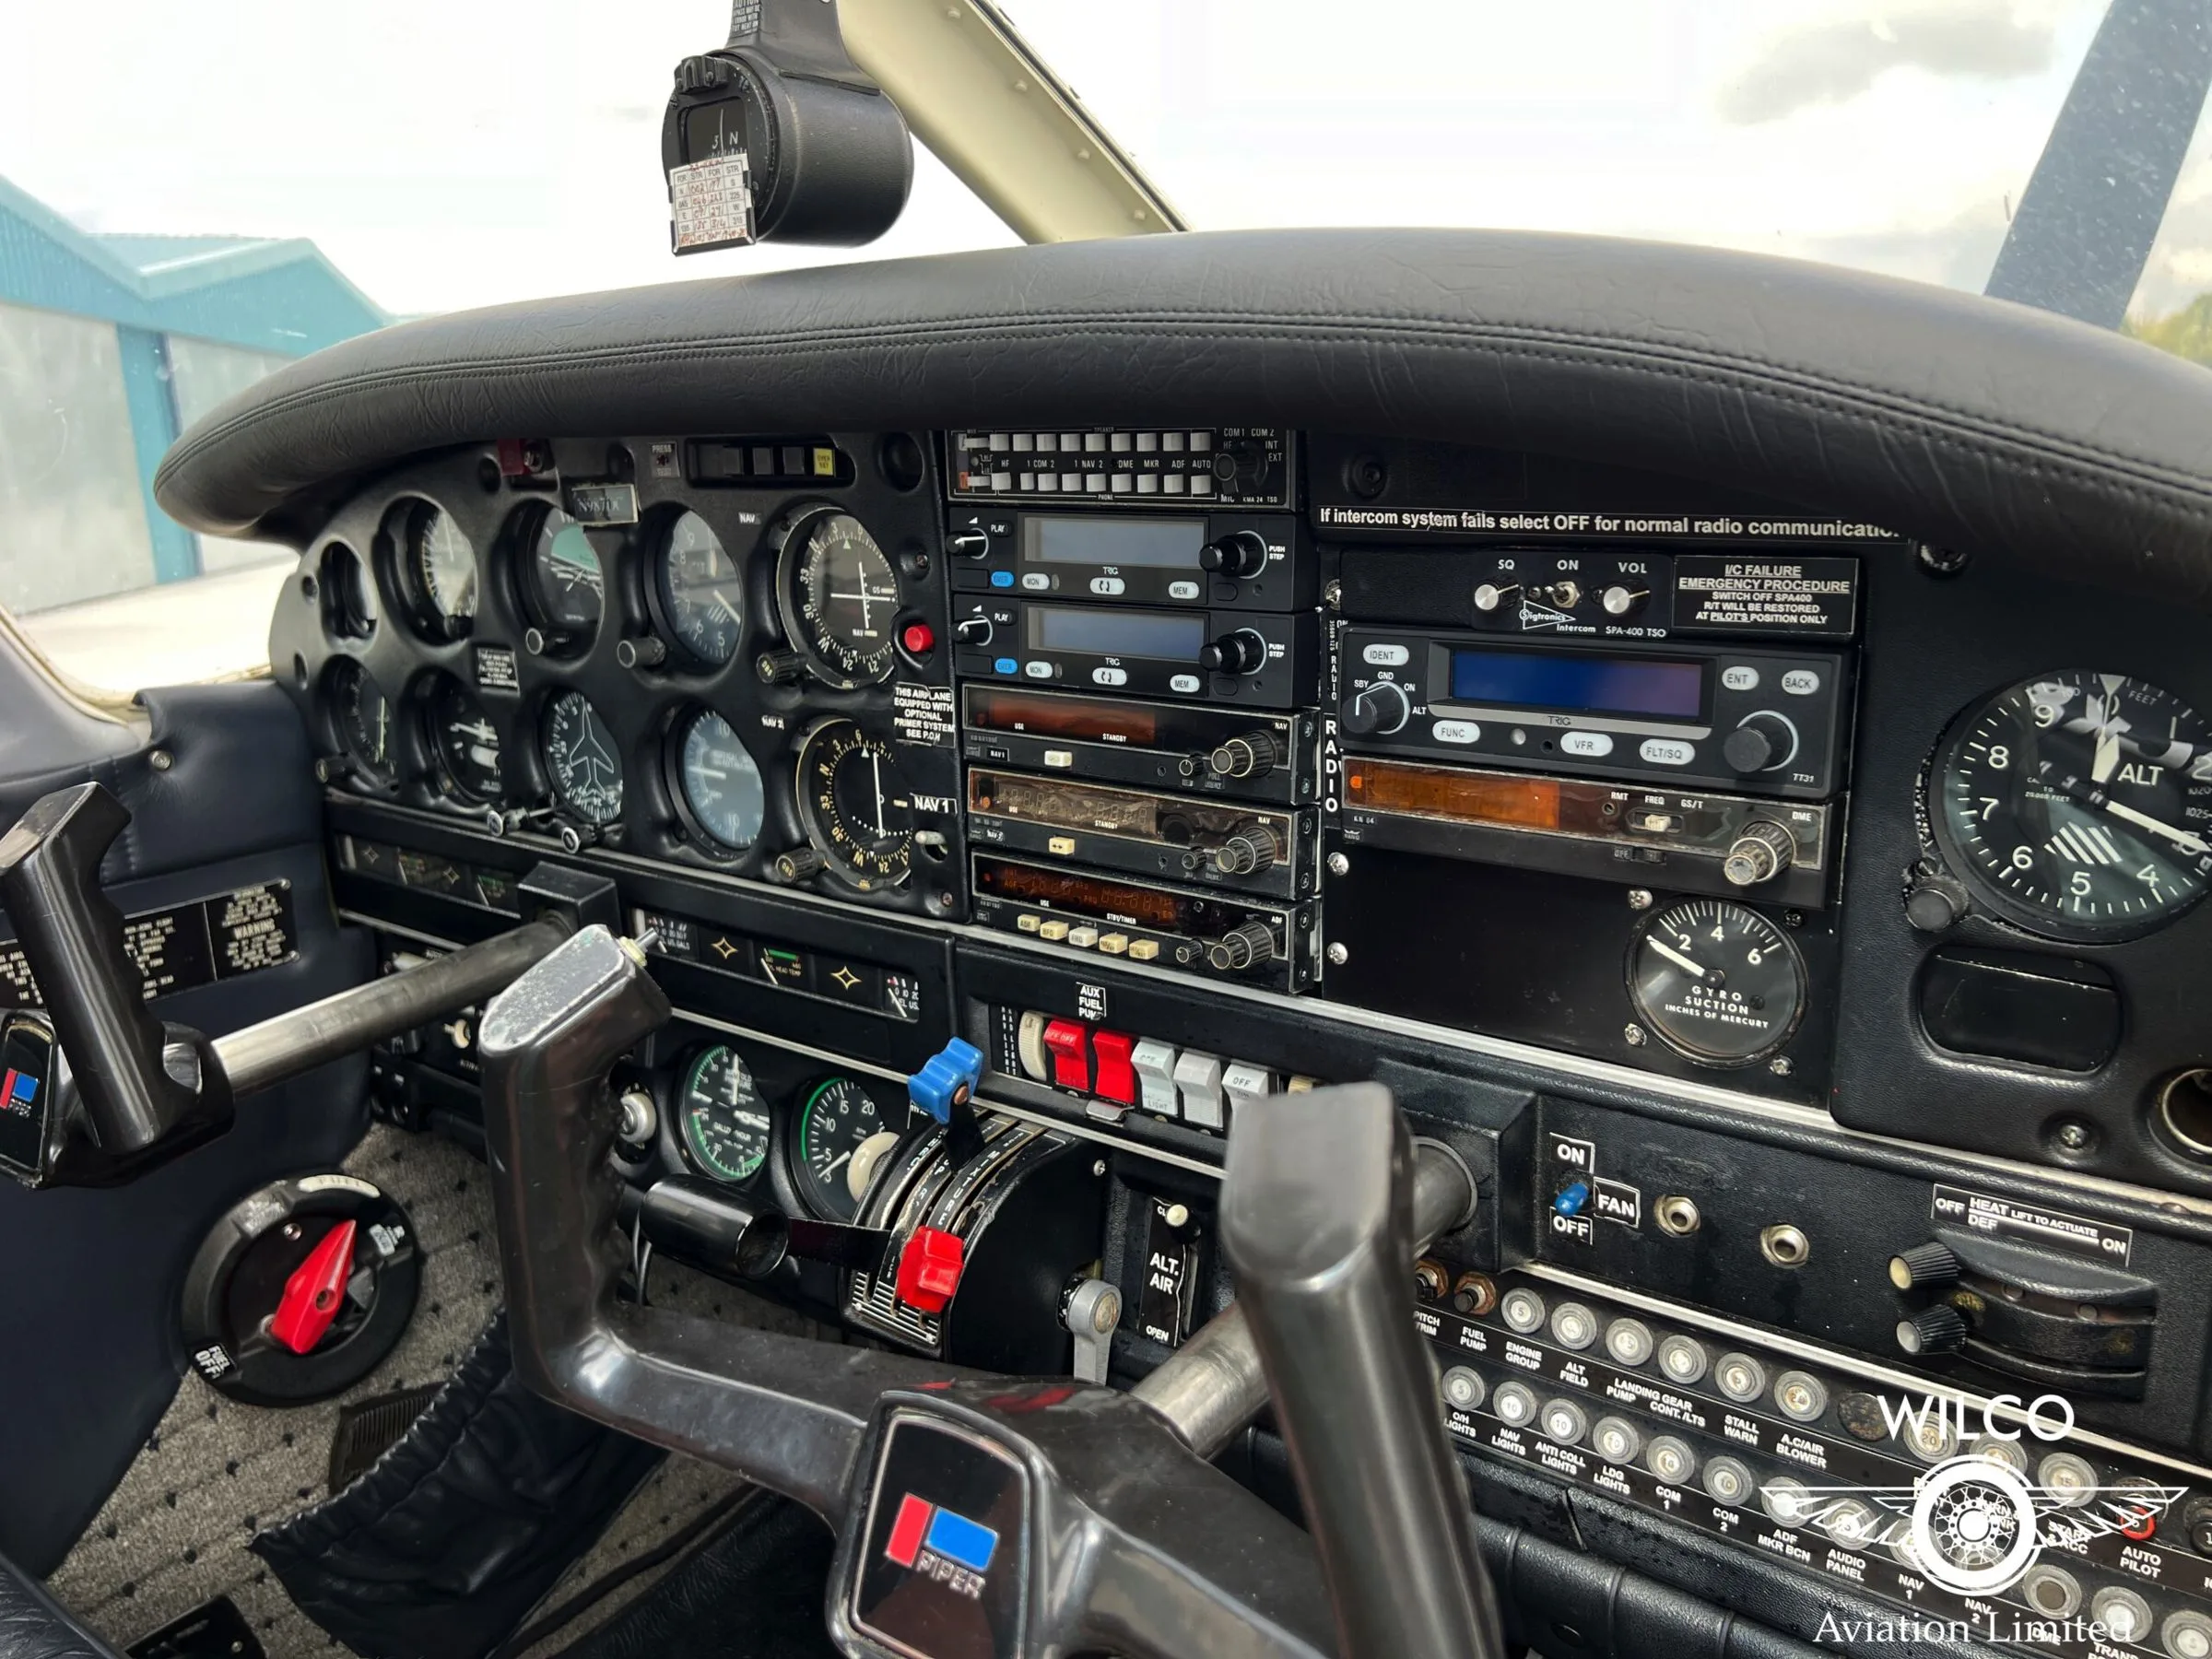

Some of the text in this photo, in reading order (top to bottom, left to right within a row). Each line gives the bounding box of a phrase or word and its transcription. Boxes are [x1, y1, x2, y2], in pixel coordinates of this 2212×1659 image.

[729, 131, 739, 145] N
[1172, 460, 1185, 469] ADF
[1192, 461, 1211, 469] AUTO
[1268, 453, 1282, 462] EXT
[990, 524, 1005, 534] PLAY
[1320, 508, 1330, 523] If
[1334, 508, 1398, 525] intercom
[1402, 512, 1457, 529] system
[1461, 512, 1495, 529] fails
[1500, 514, 1551, 530] select
[1553, 515, 1590, 530] OFF
[1594, 515, 1621, 531] for
[1625, 518, 1688, 534] normal
[1694, 518, 1743, 535] radio
[1498, 559, 1647, 574] SQ ON VOL
[1724, 564, 1802, 577] I/C FAILURE
[1174, 586, 1188, 595] MEM
[1678, 577, 1850, 592] EMERGENCY PROCEDURE
[1712, 591, 1812, 602] SWITCH OFF SPA400
[1519, 609, 1565, 622] Sigtronics
[1704, 601, 1820, 614] R/T WILL BE RESTORED
[994, 613, 1009, 622] PLAY
[1696, 611, 1827, 624] AT PILOT'S POSITION ONLY
[1557, 624, 1596, 634] Intercom
[1606, 626, 1666, 638] SPA-400 TSO
[1370, 651, 1394, 660] IDENT
[1175, 679, 1189, 688] MEM
[1378, 671, 1394, 680] GND
[1727, 673, 1748, 685] ENT
[1785, 678, 1811, 689] BACK
[1354, 680, 1369, 688] SBY
[1404, 683, 1415, 692] ON
[895, 687, 951, 701] THIS AIRPLANE
[2128, 691, 2157, 706] FEET
[894, 697, 953, 712] EQUIPPED WITH
[1412, 707, 1427, 715] ALT
[904, 709, 942, 721] OPTIONAL
[2034, 705, 2055, 728] 9
[894, 717, 955, 733] PRIMER SYSTEM
[906, 728, 921, 738] SEE
[1441, 728, 1465, 738] FUNC
[1575, 740, 1594, 751] VFR
[1646, 747, 1682, 760] FLT/SQ
[1988, 745, 2009, 769] 8
[1325, 720, 1338, 813] RADIO
[2118, 763, 2164, 786] ALT
[1792, 774, 1814, 783] TT31
[820, 795, 831, 809] 33
[913, 796, 949, 813] NAV 1
[1611, 792, 1665, 805] RMT FREQ
[1792, 811, 1811, 821] DME
[1979, 797, 2000, 820] 7
[831, 827, 844, 842] 30
[2012, 846, 2033, 869] 6
[2070, 864, 2159, 895] 5 4
[1679, 926, 1761, 965] 4 2 6
[1080, 985, 1100, 998] AUX
[1692, 985, 1742, 1001] GYRO
[1079, 996, 1103, 1011] FUEL
[1685, 995, 1749, 1014] SUCTION
[1665, 1004, 1768, 1029] INCHES OF MERCURY
[1233, 1076, 1251, 1087] OFF
[840, 1100, 875, 1116] 15 20
[824, 1118, 836, 1132] 10
[1557, 1143, 1585, 1165] ON
[938, 1150, 1000, 1226] MIXTURE
[1598, 1194, 1635, 1218] FAN
[1970, 1197, 2098, 1238] HEAT LIFT TO ACTUATE
[1553, 1216, 1589, 1237] OFF
[1935, 1198, 2127, 1255] OFF DEF ON
[1149, 1252, 1179, 1276] ALT.
[1149, 1272, 1174, 1295] AIR
[1146, 1325, 1170, 1341] OPEN
[1462, 1326, 1487, 1342] FUEL
[1460, 1336, 1487, 1352] PUMP
[1506, 1341, 1542, 1362] ENGINE
[194, 1349, 225, 1379] OFF
[207, 1345, 231, 1371] FUEL
[1506, 1351, 1540, 1371] GROUP
[1565, 1361, 1586, 1376] ALT
[1560, 1370, 1589, 1388] FIELD
[1614, 1377, 1693, 1412] LANDING GEAR
[1606, 1385, 1706, 1428] PUMP CONT. /LTS
[1452, 1412, 1470, 1424] O/H
[1724, 1414, 1760, 1435] STALL
[1444, 1418, 1477, 1438] LIGHTS
[1499, 1428, 1520, 1442] NAV
[1724, 1426, 1759, 1446] WARN
[1492, 1436, 1526, 1456] LIGHTS
[1780, 1433, 1825, 1457] A.C/AIR
[1535, 1441, 1586, 1468] ANTI COLL
[1776, 1443, 1827, 1470] BLOWER
[1542, 1454, 1577, 1475] LIGHTS
[1602, 1465, 1624, 1481] LDG
[1594, 1473, 1630, 1495] LIGHTS
[1656, 1486, 1681, 1503] COM
[1664, 1500, 1670, 1510] 1
[1712, 1507, 1739, 1524] COM
[1720, 1521, 1728, 1532] 2
[1773, 1529, 1798, 1545] ADF
[1758, 1534, 1811, 1562] MKR BCN
[2122, 1546, 2162, 1566] AUTO
[1827, 1549, 1866, 1569] AUDIO
[915, 1549, 987, 1600] PIPER
[1826, 1559, 1865, 1582] PANEL
[2120, 1557, 2161, 1579] PILOT
[1899, 1573, 1925, 1591] NAV
[1906, 1589, 1913, 1600] 1
[1964, 1597, 1992, 1615] NAV
